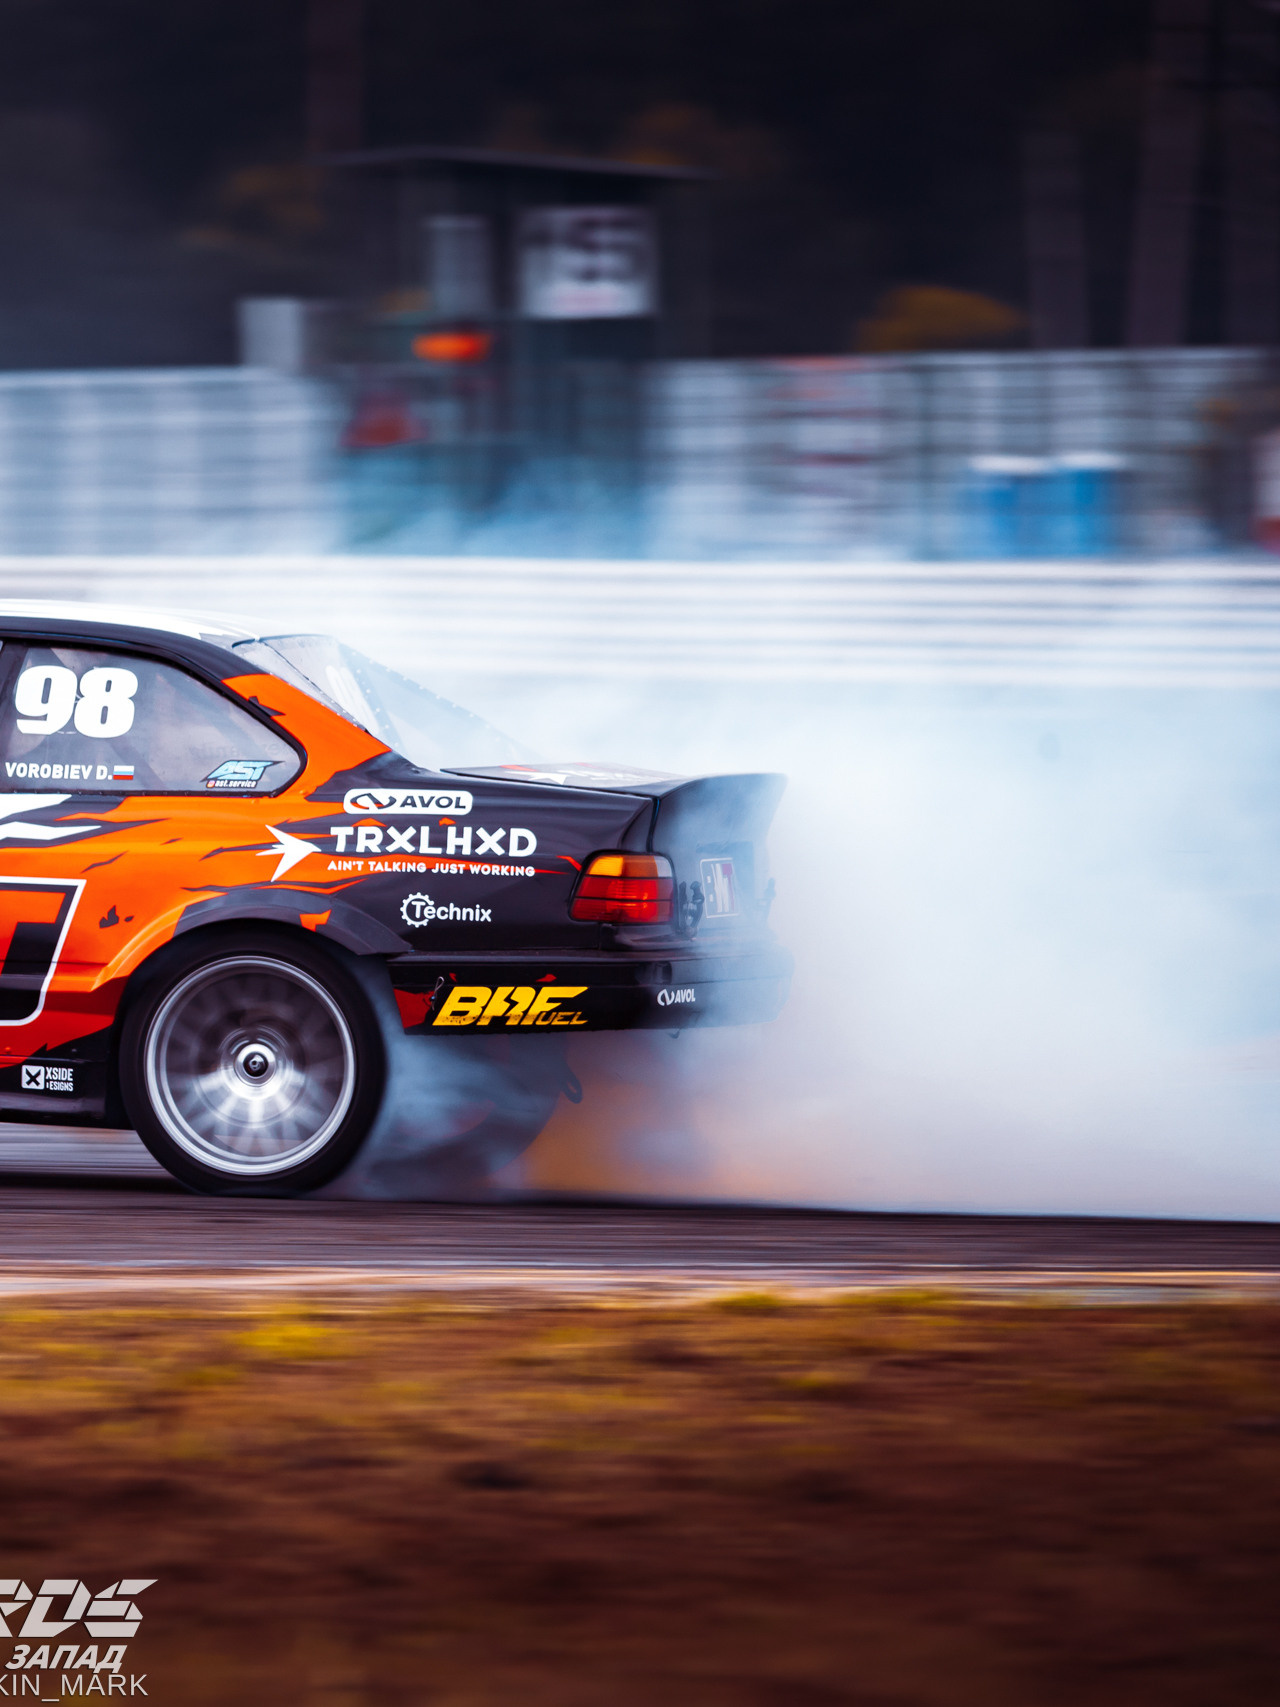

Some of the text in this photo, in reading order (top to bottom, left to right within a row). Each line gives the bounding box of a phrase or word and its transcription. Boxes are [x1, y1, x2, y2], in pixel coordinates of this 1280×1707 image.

[15, 665, 138, 738] 98
[5, 762, 113, 780] VOROBIEV D.
[400, 795, 466, 809] AVOL
[330, 826, 537, 857] TRXLHXD
[327, 860, 536, 877] AIN'T TALKING JUST WORKING
[411, 900, 492, 922] Technix
[674, 988, 696, 1004] AVOL
[46, 1067, 73, 1081] XSIDE
